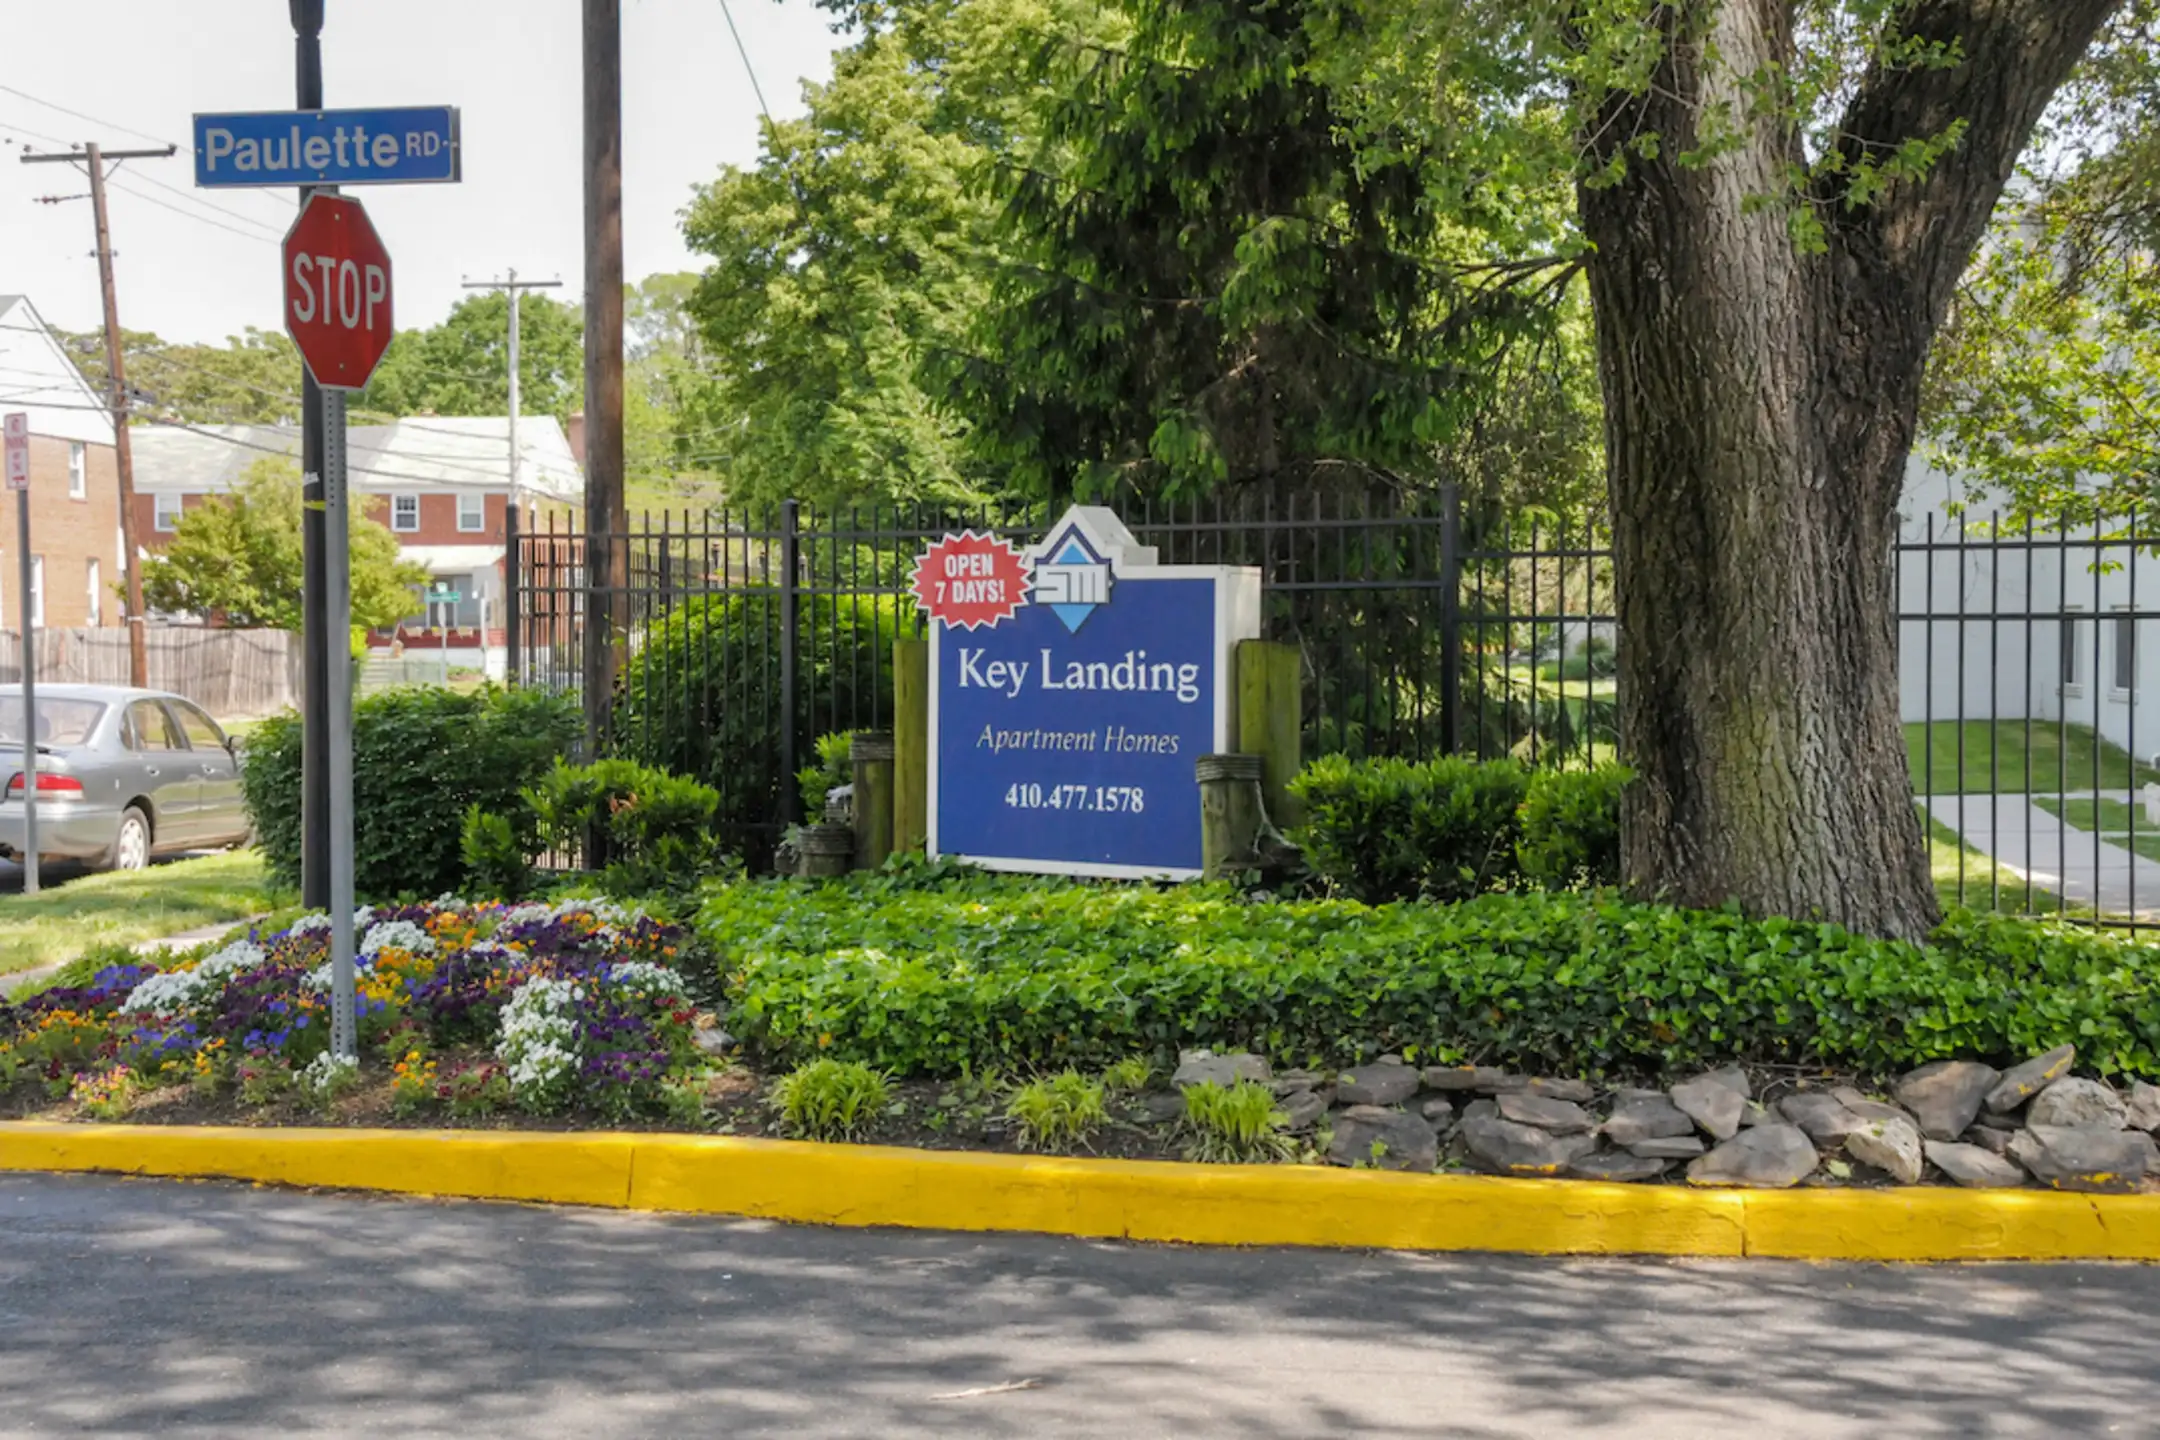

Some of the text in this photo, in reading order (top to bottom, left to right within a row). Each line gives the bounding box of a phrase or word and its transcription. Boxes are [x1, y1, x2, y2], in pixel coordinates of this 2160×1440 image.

[205, 125, 440, 172] Paulette RD
[293, 251, 386, 331] STOP
[944, 553, 994, 577] OPEN
[934, 579, 1005, 604] 7 DAYS!
[958, 648, 1200, 703] Key Landing
[976, 724, 1180, 755] Apartment Homes
[1005, 783, 1145, 814] 410.477.1578
